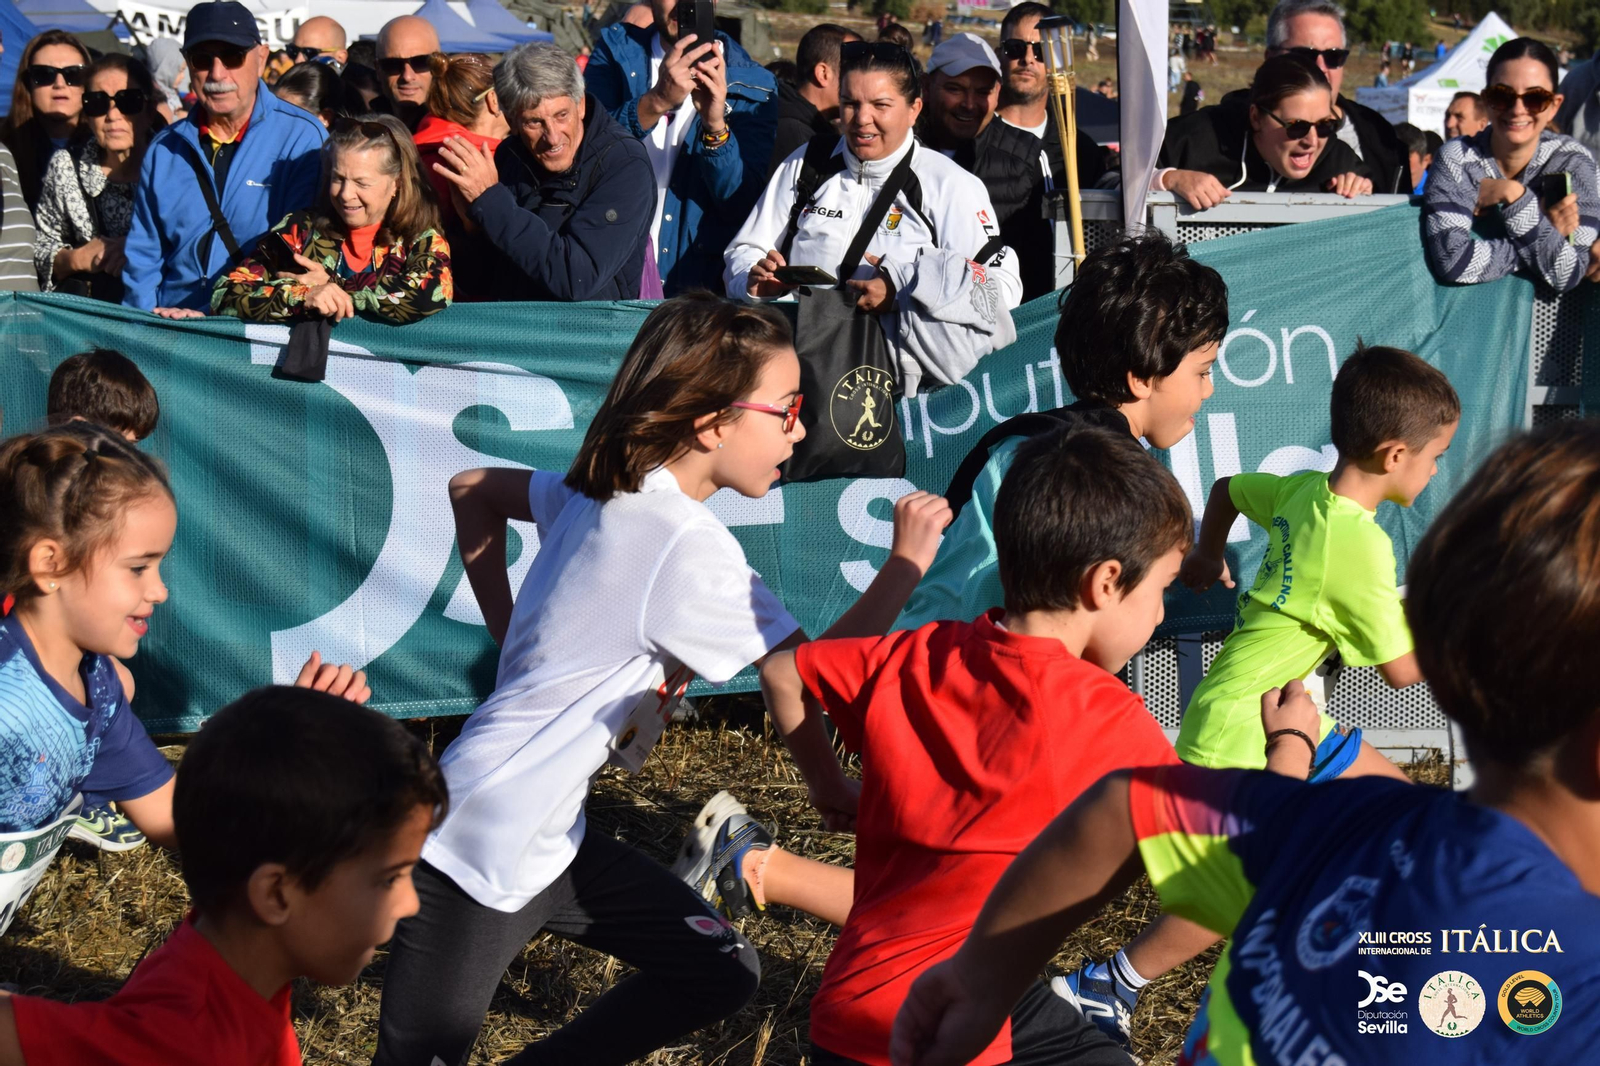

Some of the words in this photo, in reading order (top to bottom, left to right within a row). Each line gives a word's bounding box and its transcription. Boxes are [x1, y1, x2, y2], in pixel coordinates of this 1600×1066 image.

[130, 10, 299, 43] AMGÚ
[811, 206, 844, 219] EGEA
[837, 370, 893, 400] ITÁLIC
[901, 309, 1337, 459] iputón
